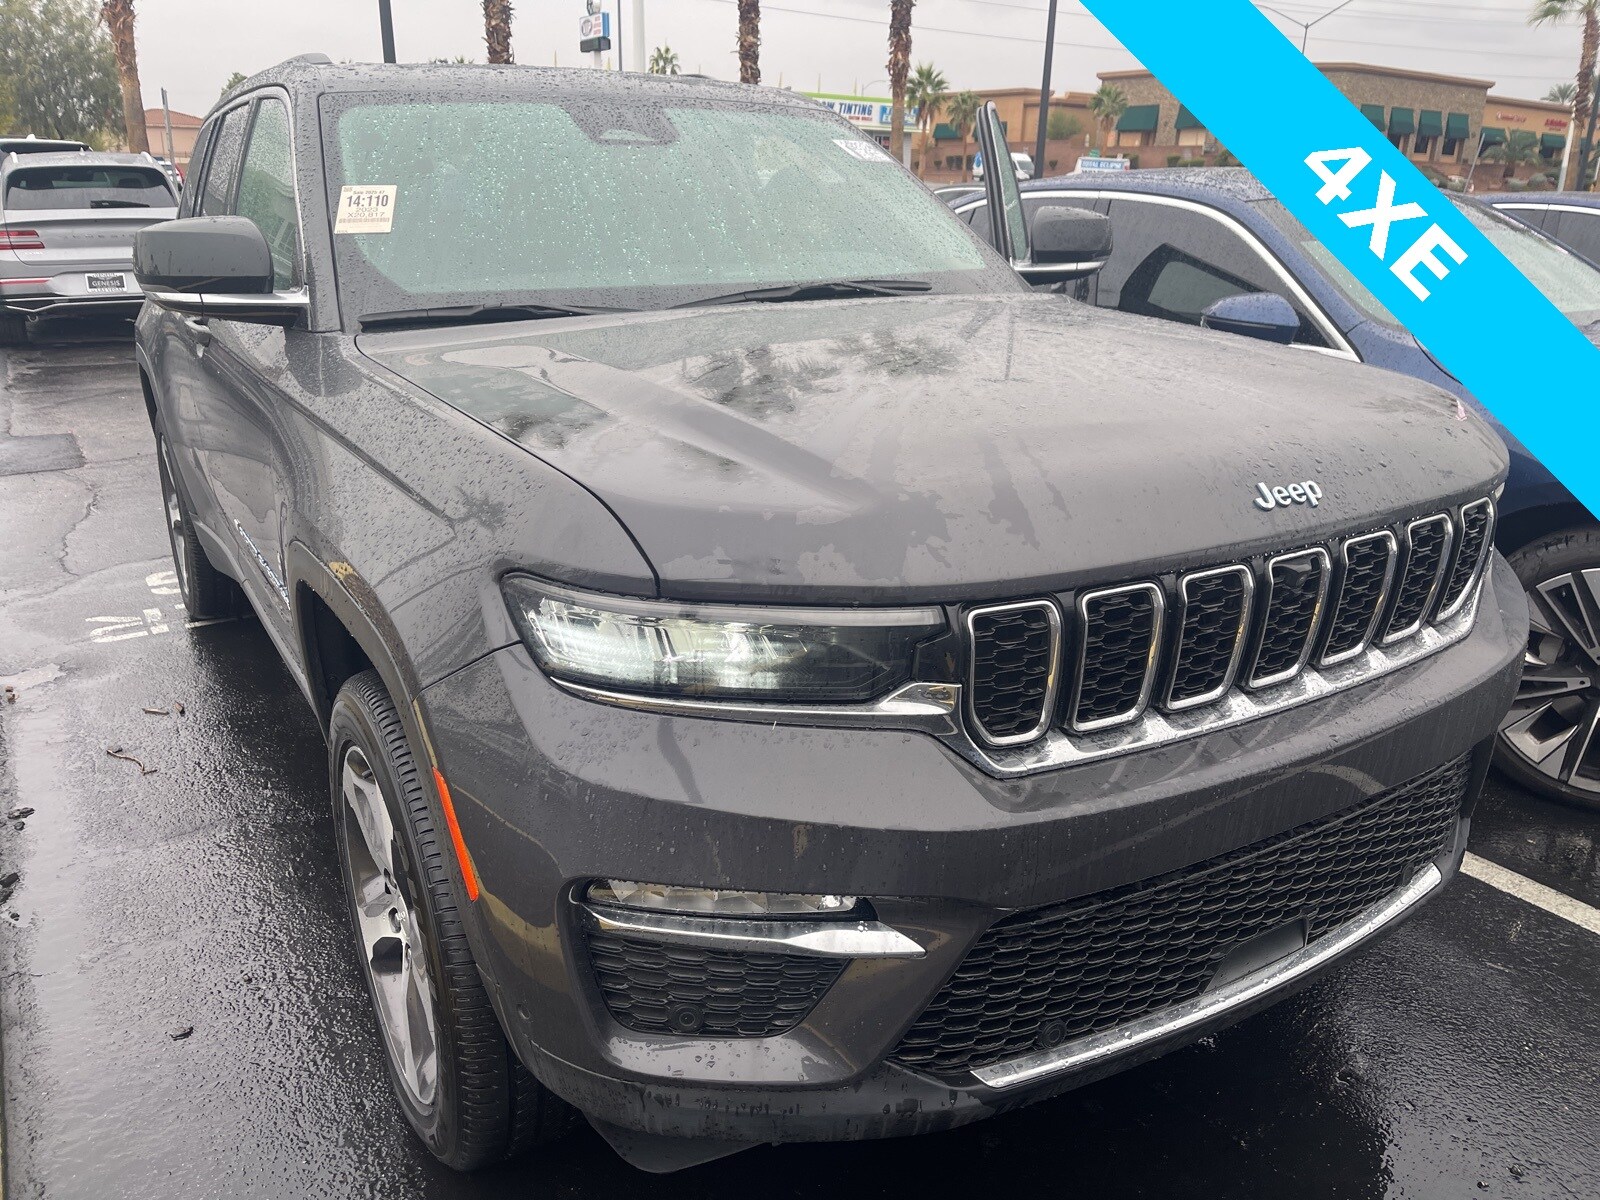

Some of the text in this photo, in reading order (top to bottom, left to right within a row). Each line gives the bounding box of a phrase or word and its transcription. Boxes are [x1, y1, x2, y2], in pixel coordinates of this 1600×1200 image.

[839, 102, 873, 116] TINTING
[347, 195, 389, 207] 14:110
[1254, 480, 1323, 510] Jeep
